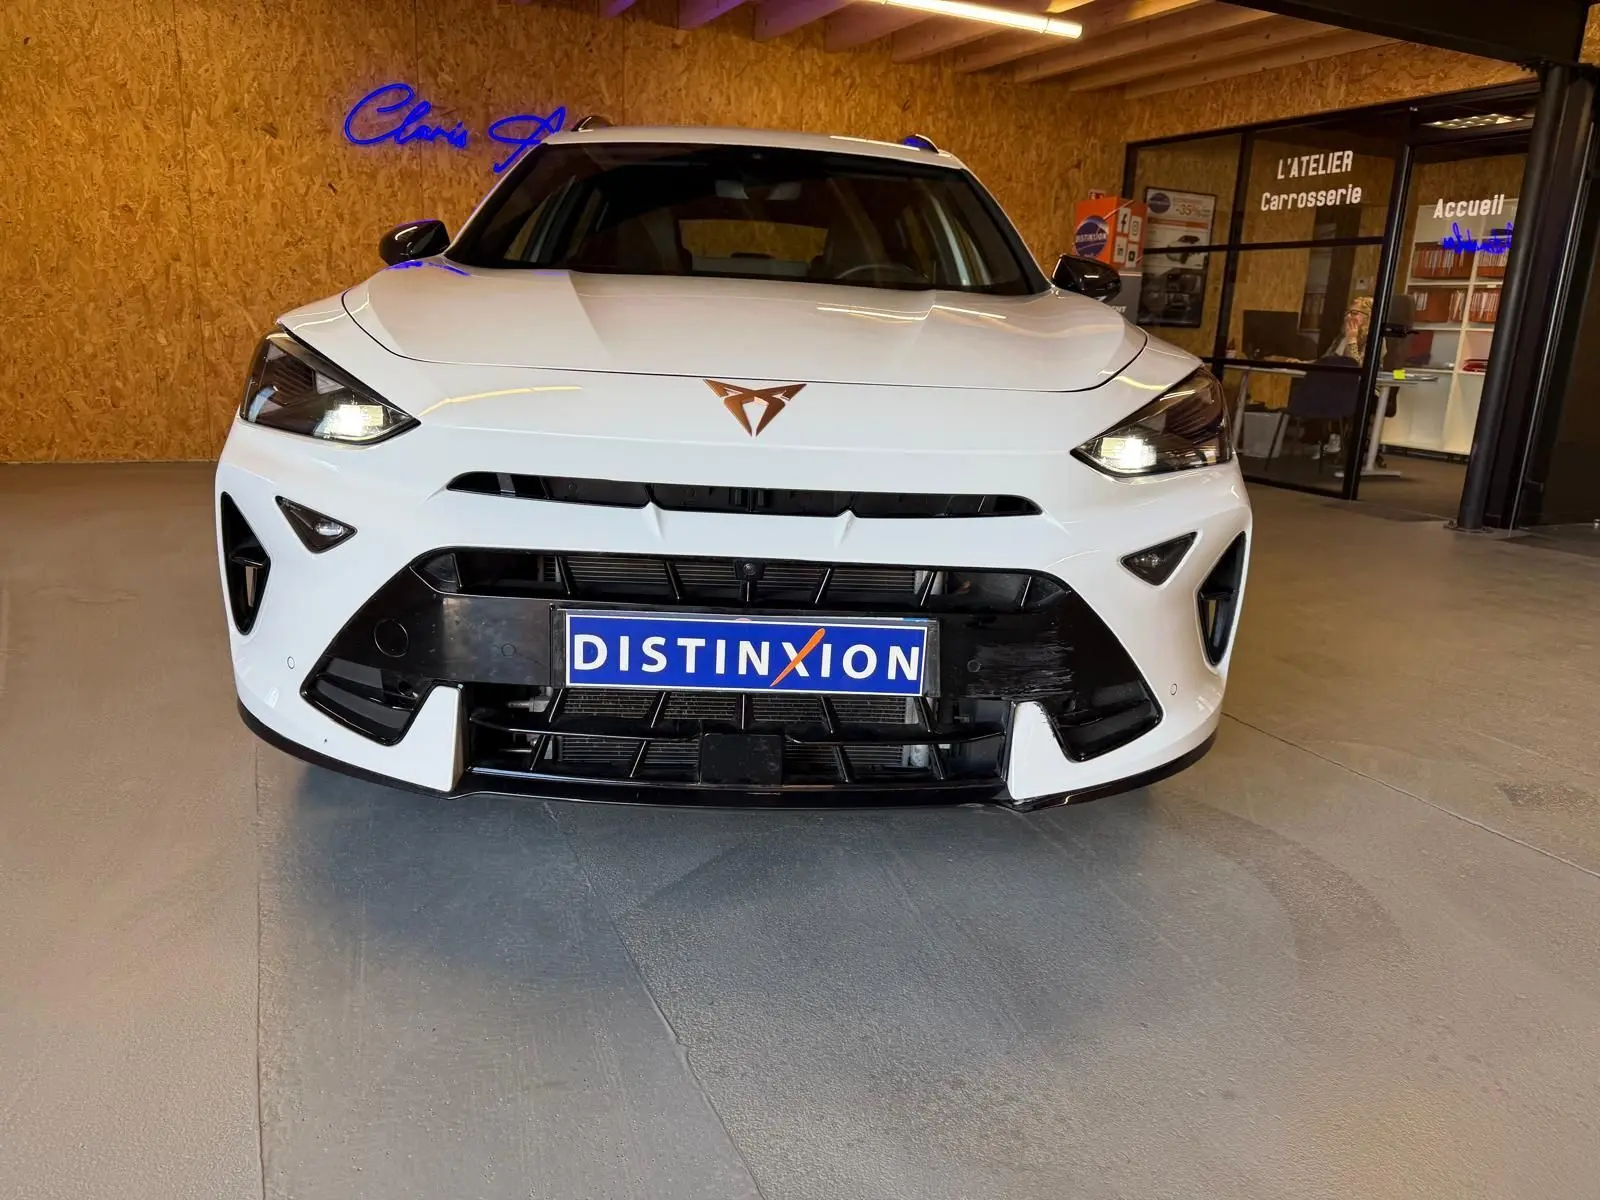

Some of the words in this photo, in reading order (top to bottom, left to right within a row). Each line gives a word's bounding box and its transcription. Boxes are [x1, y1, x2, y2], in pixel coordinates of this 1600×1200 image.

[1277, 150, 1354, 180] L'ATELIER
[1261, 184, 1362, 211] Carrosserie
[1432, 194, 1505, 219] Accueil
[573, 628, 920, 687] DISTINXION
